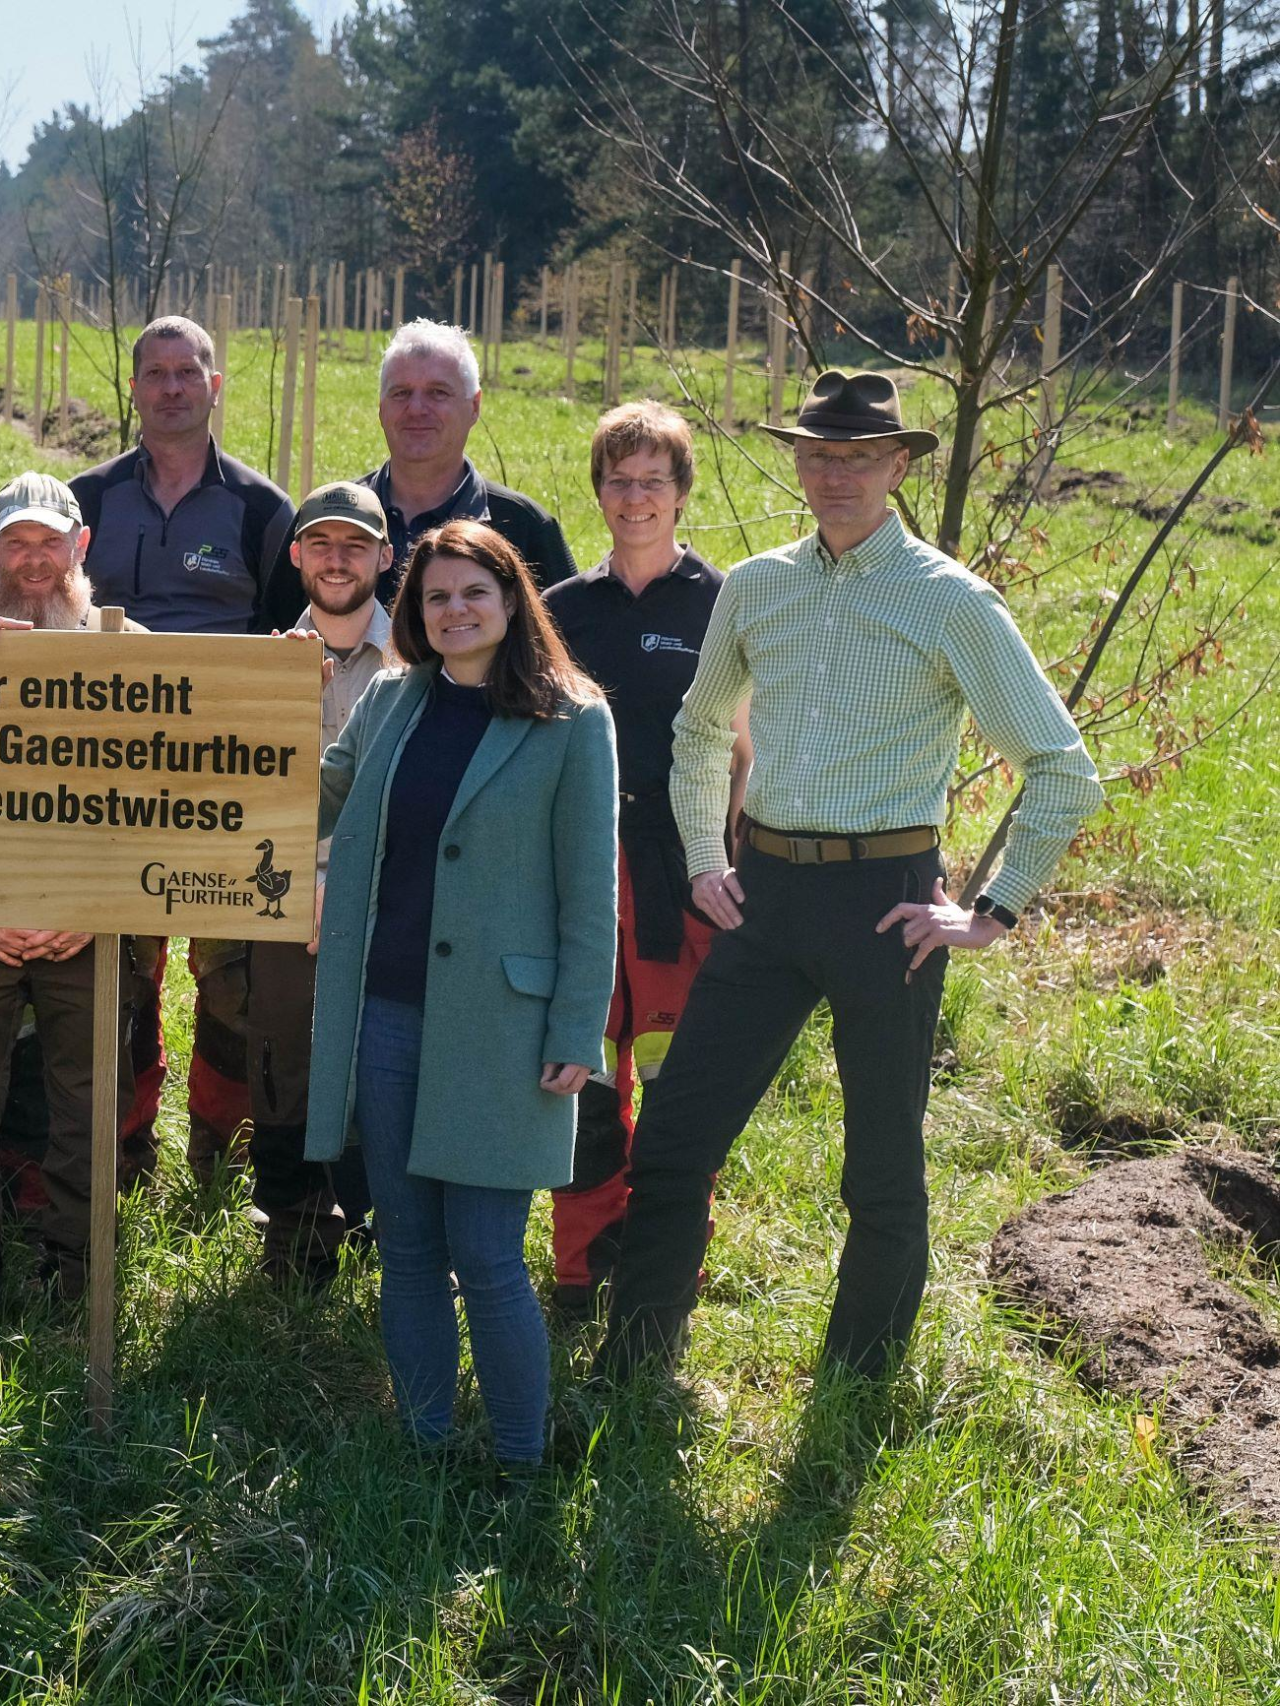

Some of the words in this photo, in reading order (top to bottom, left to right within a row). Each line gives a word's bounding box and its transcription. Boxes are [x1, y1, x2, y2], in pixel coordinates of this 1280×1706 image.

[20, 672, 192, 715] entsteht
[0, 724, 296, 776] Gaensefurther
[165, 882, 255, 914] FURTHER
